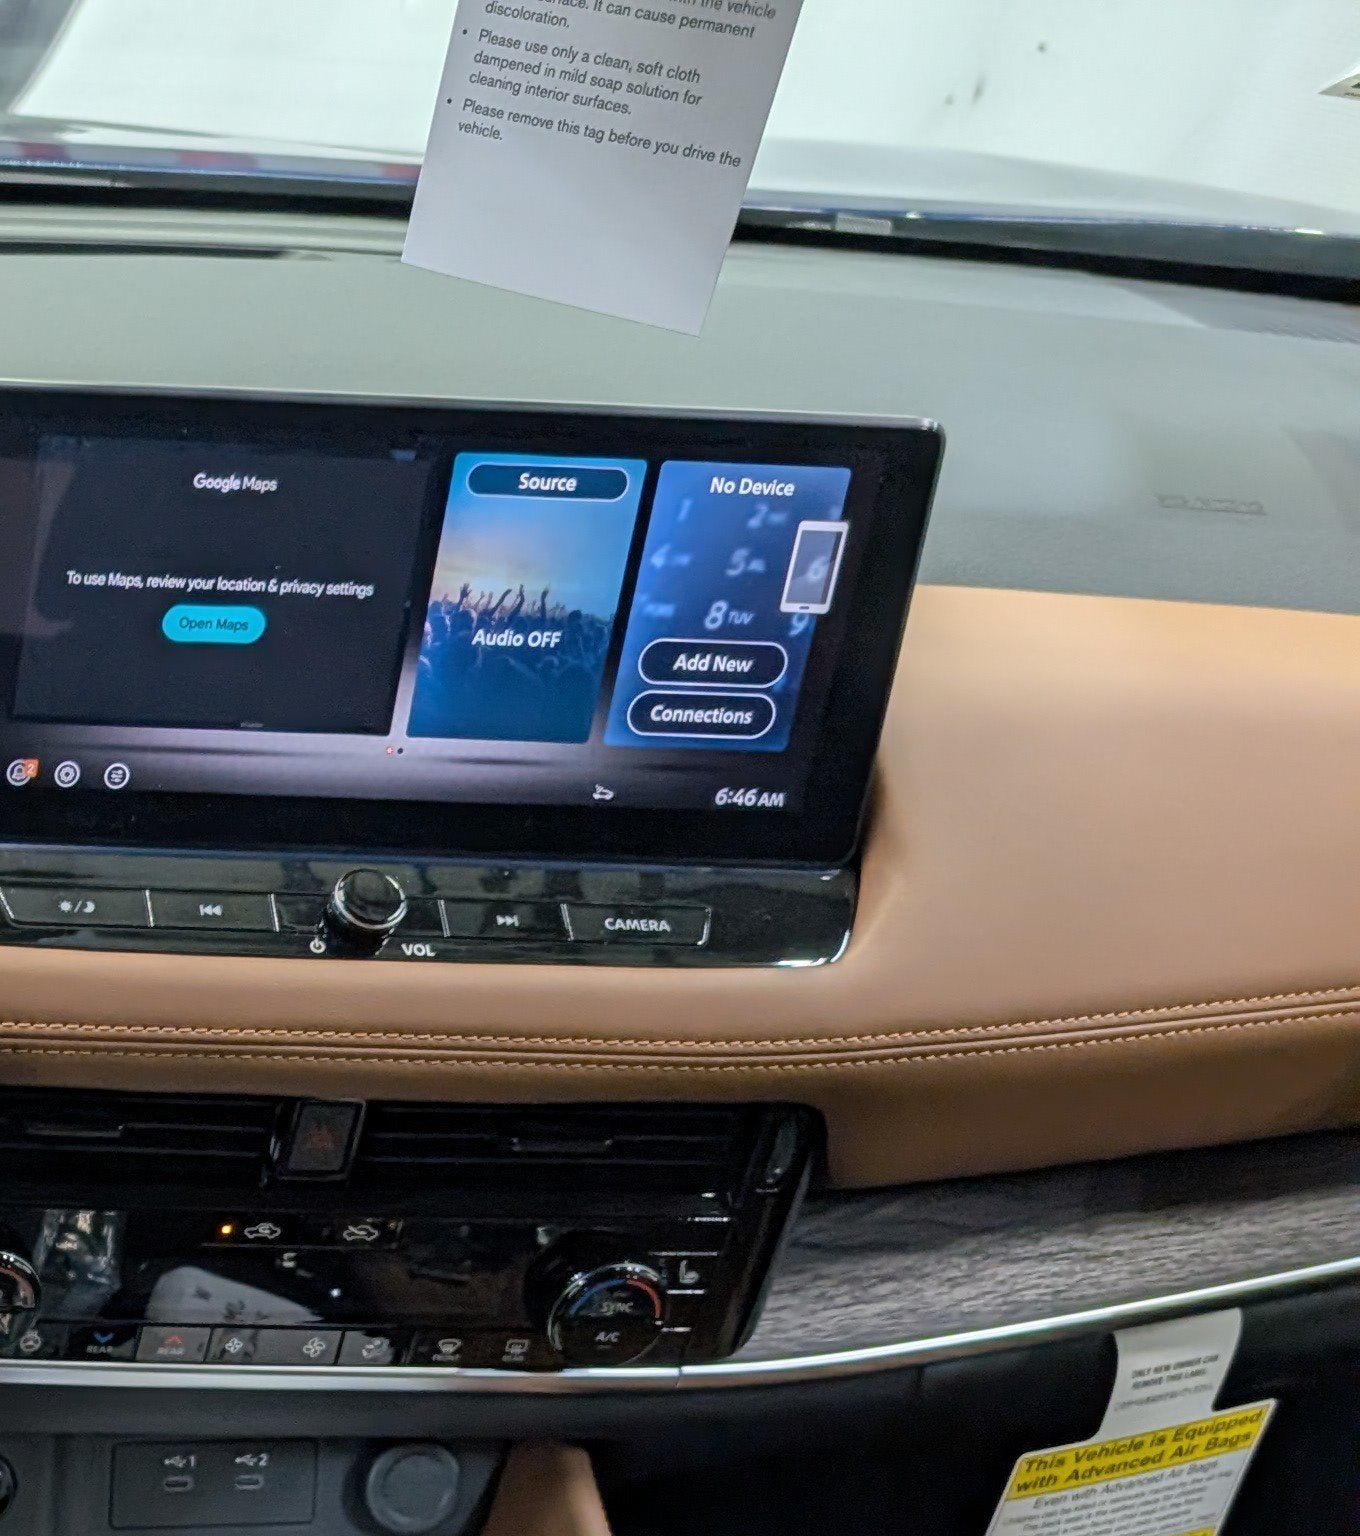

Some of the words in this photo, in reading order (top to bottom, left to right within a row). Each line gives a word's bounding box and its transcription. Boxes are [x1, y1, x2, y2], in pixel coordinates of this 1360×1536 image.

[484, 2, 570, 28] discoloration.
[606, 3, 631, 17] can
[634, 7, 676, 25] cause
[678, 15, 755, 38] permanent
[727, 0, 777, 19] vehicle
[478, 28, 522, 50] Please
[524, 41, 549, 55] use
[551, 45, 580, 64] only
[581, 52, 590, 64] a
[593, 53, 632, 74] clean,
[636, 61, 664, 77] soft
[666, 65, 701, 84] cloth
[473, 50, 542, 75] dampened
[544, 63, 556, 78] in
[559, 68, 588, 84] mild
[590, 76, 623, 94] soap
[626, 81, 679, 102] solution
[682, 89, 703, 106] for
[469, 71, 522, 97] cleaning
[524, 80, 570, 102] interior
[572, 94, 632, 115] surfaces.
[458, 121, 503, 141] vehicle.
[462, 98, 505, 119] Please
[507, 110, 554, 130] remove
[557, 118, 580, 135] this
[583, 125, 605, 144] tag
[608, 128, 651, 150] before
[653, 140, 679, 155] you
[682, 143, 716, 162] drive
[719, 150, 742, 168] the
[192, 472, 241, 494] Google
[242, 474, 278, 495] Maps
[517, 471, 578, 493] Source
[710, 476, 735, 495] No
[738, 477, 796, 497] Device
[66, 570, 81, 586] To
[83, 573, 107, 587] use
[107, 572, 144, 589] Maps,
[146, 574, 186, 589] review
[187, 577, 215, 592] your
[216, 576, 267, 593] location
[268, 578, 279, 593] &
[279, 579, 326, 598] privacy
[326, 580, 375, 600] settings
[179, 616, 212, 633] Open
[215, 617, 250, 634] Maps
[471, 627, 524, 648] Audio
[526, 630, 562, 649] OFF
[672, 654, 710, 672] Add
[713, 655, 754, 674] New
[649, 704, 754, 726] Connections
[603, 917, 671, 933] CAMERA
[401, 943, 436, 958] VOL
[595, 1330, 620, 1343] A/C
[1025, 1455, 1066, 1473] This
[1074, 1438, 1145, 1464] Vehicle
[1149, 1432, 1167, 1448] is
[1171, 1408, 1264, 1443] Equipped
[258, 1452, 269, 1467] 2
[1017, 1473, 1058, 1492] with
[1064, 1450, 1166, 1483] Advanced
[1169, 1444, 1200, 1459] Air
[1204, 1431, 1253, 1451] Bags
